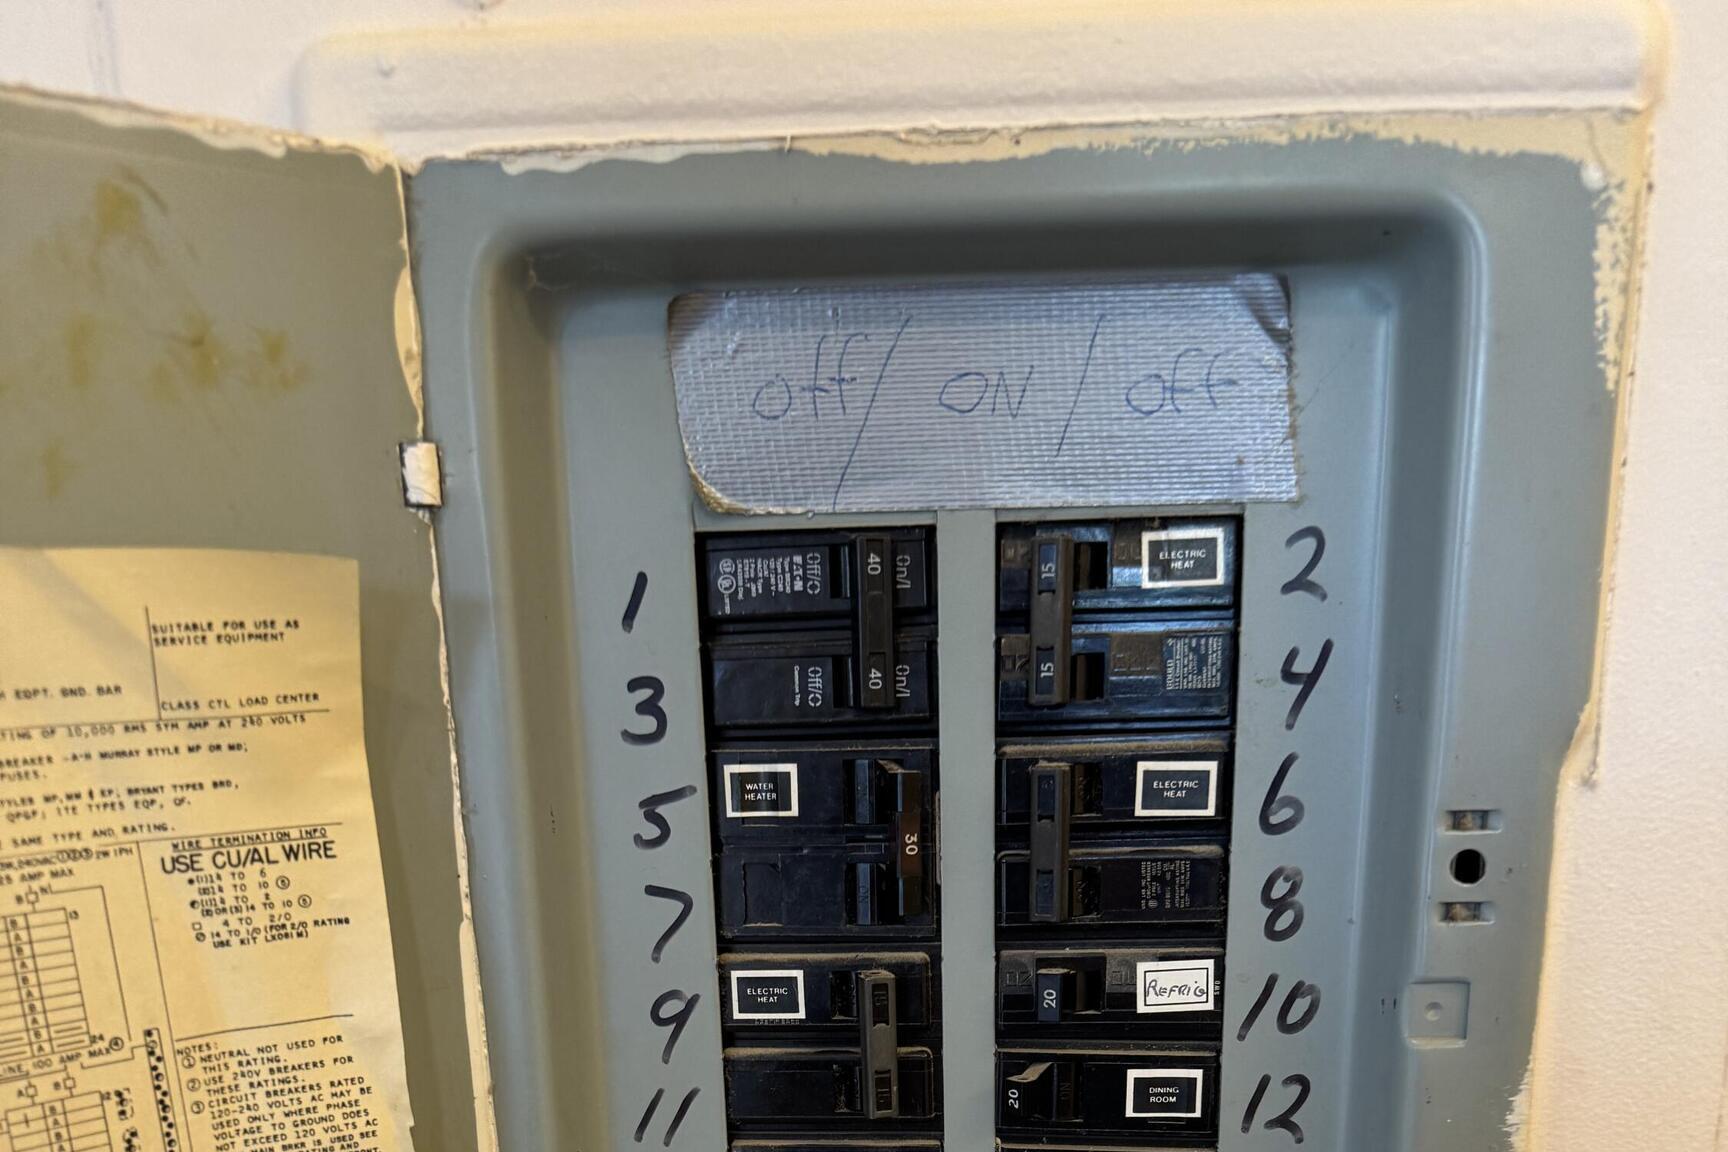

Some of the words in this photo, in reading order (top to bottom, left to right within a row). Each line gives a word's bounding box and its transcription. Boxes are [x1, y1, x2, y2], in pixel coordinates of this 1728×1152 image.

[867, 553, 881, 575] 40
[1159, 549, 1206, 560] ELECTRIC
[1171, 560, 1194, 570] HEAT
[1281, 526, 1328, 602] 2
[1041, 562, 1056, 579] 15
[621, 570, 649, 634] 1
[152, 621, 213, 634] SUITABLE
[223, 621, 245, 631] FOR
[254, 620, 276, 630] USE
[285, 619, 300, 629] AS
[153, 635, 208, 647] SERVICE
[217, 632, 285, 644] EQUIPMENT
[868, 668, 882, 690] 40
[1040, 662, 1054, 678] 15
[1280, 638, 1334, 730] 4
[161, 700, 200, 711] CLASS
[208, 699, 231, 709] CTL
[239, 696, 268, 707] LOAD
[276, 692, 320, 705] CENTER
[620, 675, 668, 746] 3
[218, 719, 232, 728] AT
[271, 714, 306, 725] VOLTS
[147, 745, 180, 757] STYLE
[172, 782, 204, 793] TYPES
[745, 783, 774, 791] WATER
[1153, 780, 1200, 790] ELECTRIC
[1163, 790, 1187, 798] HEAT
[1259, 752, 1305, 836] 6
[88, 802, 125, 812] TYPES
[744, 792, 777, 801] HEATER
[633, 784, 698, 850] 5
[92, 827, 115, 838] AND
[172, 839, 201, 850] WIRE
[211, 831, 290, 847] TERMINATION
[299, 828, 327, 839] INFO
[905, 833, 918, 855] 30
[161, 853, 203, 874] USE
[212, 846, 279, 869] CU/AL
[282, 840, 337, 862] WIRE
[231, 871, 245, 881] TO
[233, 883, 247, 893] TO
[1260, 865, 1304, 942] 8
[314, 917, 350, 927] RATING
[644, 884, 694, 964] 7
[747, 987, 788, 995] ELECTRIC
[1043, 988, 1057, 1009] 20
[1236, 972, 1321, 1041] 10
[650, 989, 701, 1064] 9
[177, 1042, 218, 1056] NOTES:
[200, 1049, 250, 1063] NEUTRAL
[257, 1044, 278, 1055] NOT
[287, 1040, 315, 1050] USED
[322, 1035, 344, 1045] FOR
[202, 1064, 230, 1074] THIS
[238, 1055, 288, 1068] RATING.
[204, 1076, 224, 1087] USE
[232, 1070, 261, 1081] 240V
[269, 1060, 325, 1075] BREAKERS
[333, 1056, 354, 1066] FOR
[206, 1085, 241, 1097] THESE
[249, 1076, 305, 1089] RATINGS.
[208, 1093, 257, 1108] CIRCUIT
[265, 1083, 322, 1098] BREAKERS
[330, 1077, 365, 1088] RATED
[211, 1104, 260, 1119] 120-240
[267, 1097, 303, 1109] VOLTS
[310, 1094, 324, 1103] AC
[331, 1089, 351, 1099] MAY
[360, 1086, 373, 1095] BE
[1008, 1089, 1019, 1109] 20
[1150, 1095, 1177, 1103] ROOM
[1241, 1073, 1311, 1144] 12
[211, 1119, 240, 1131] USED
[247, 1112, 275, 1124] ONLY
[283, 1106, 319, 1118] WHERE
[326, 1100, 360, 1111] PHASE
[214, 1126, 262, 1141] VOLTAGE
[271, 1122, 285, 1132] TO
[293, 1115, 335, 1128] GROUND
[342, 1109, 369, 1120] DOES
[634, 1087, 701, 1147] 11
[216, 1141, 239, 1152] NOT
[244, 1134, 287, 1147] EXCEED
[295, 1129, 316, 1139] 120
[322, 1122, 358, 1134] VOLTS
[365, 1119, 379, 1127] AC
[281, 1142, 306, 1152] BRKR
[313, 1139, 322, 1147] IS
[330, 1134, 355, 1144] USED
[359, 1130, 378, 1139] SEE
[340, 1142, 359, 1151] AND
